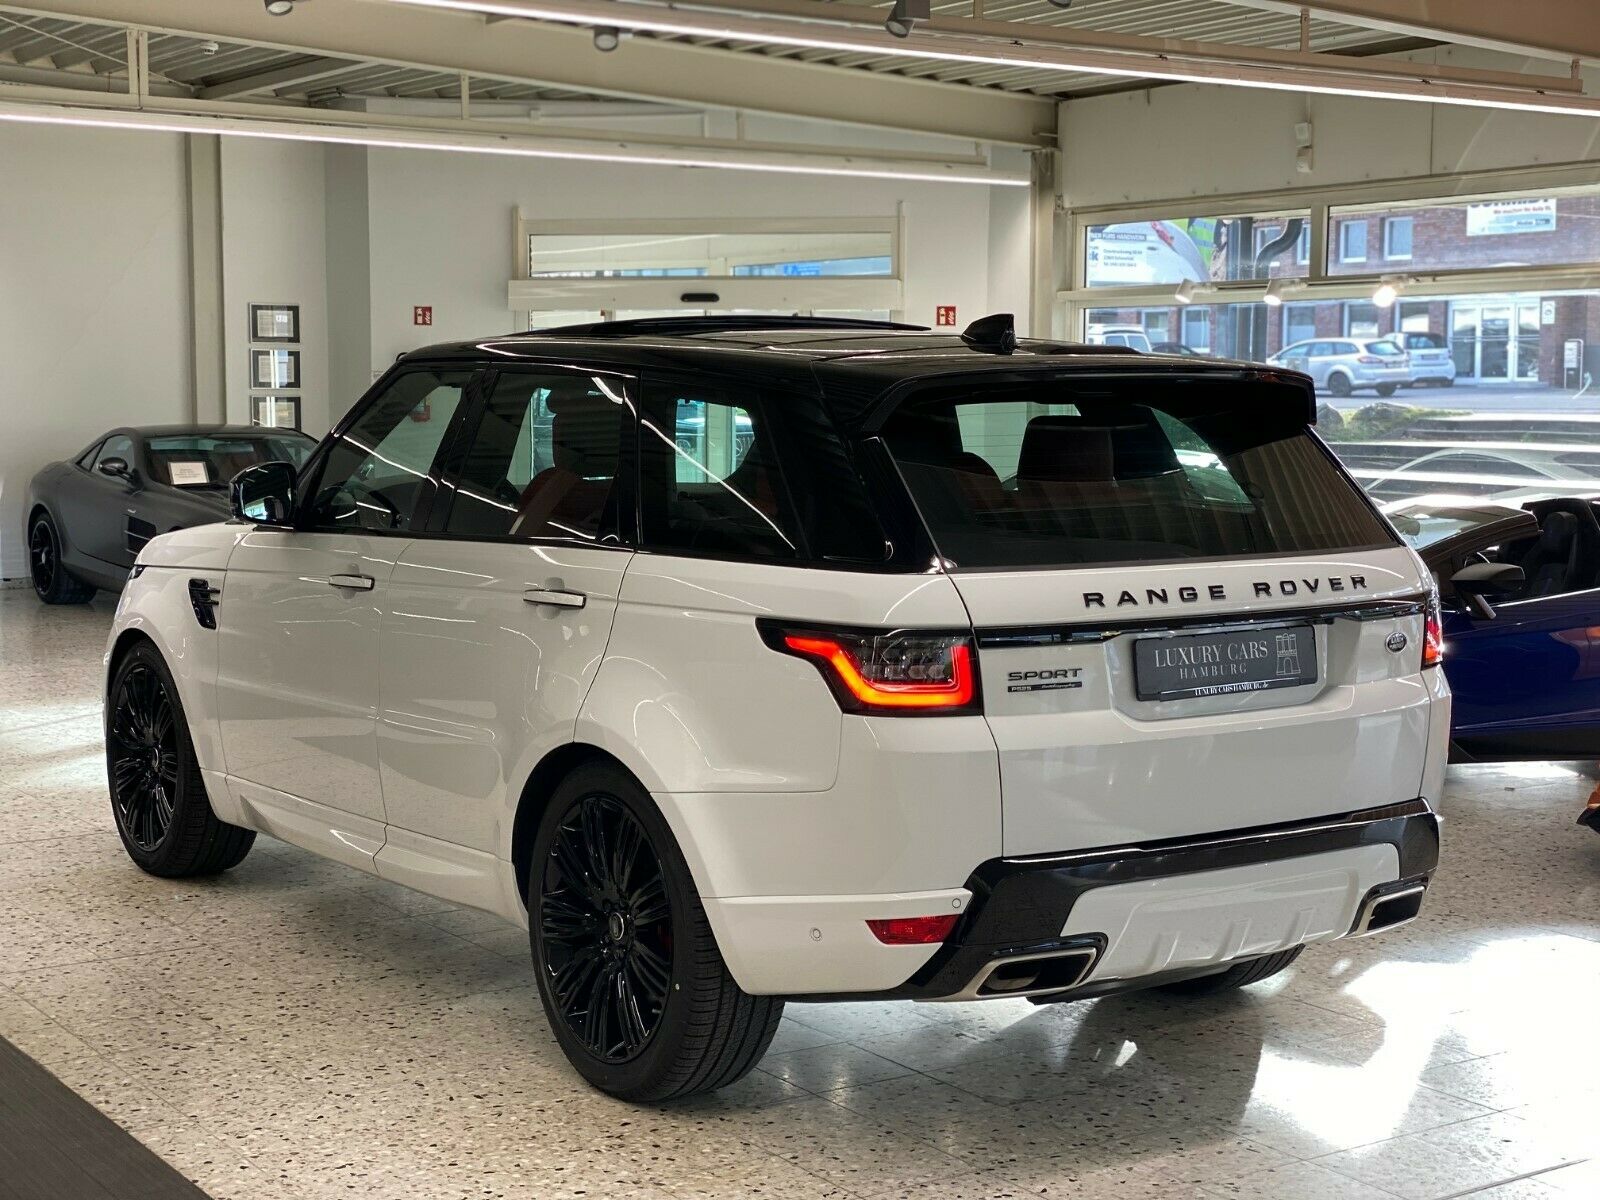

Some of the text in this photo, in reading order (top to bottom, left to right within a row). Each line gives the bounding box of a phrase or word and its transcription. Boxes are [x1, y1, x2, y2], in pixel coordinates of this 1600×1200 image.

[1083, 575, 1368, 608] RANGE ROVER
[1155, 640, 1268, 668] LUXURY CARS
[1008, 668, 1082, 681] SPORT
[1180, 662, 1247, 680] HAMBURG
